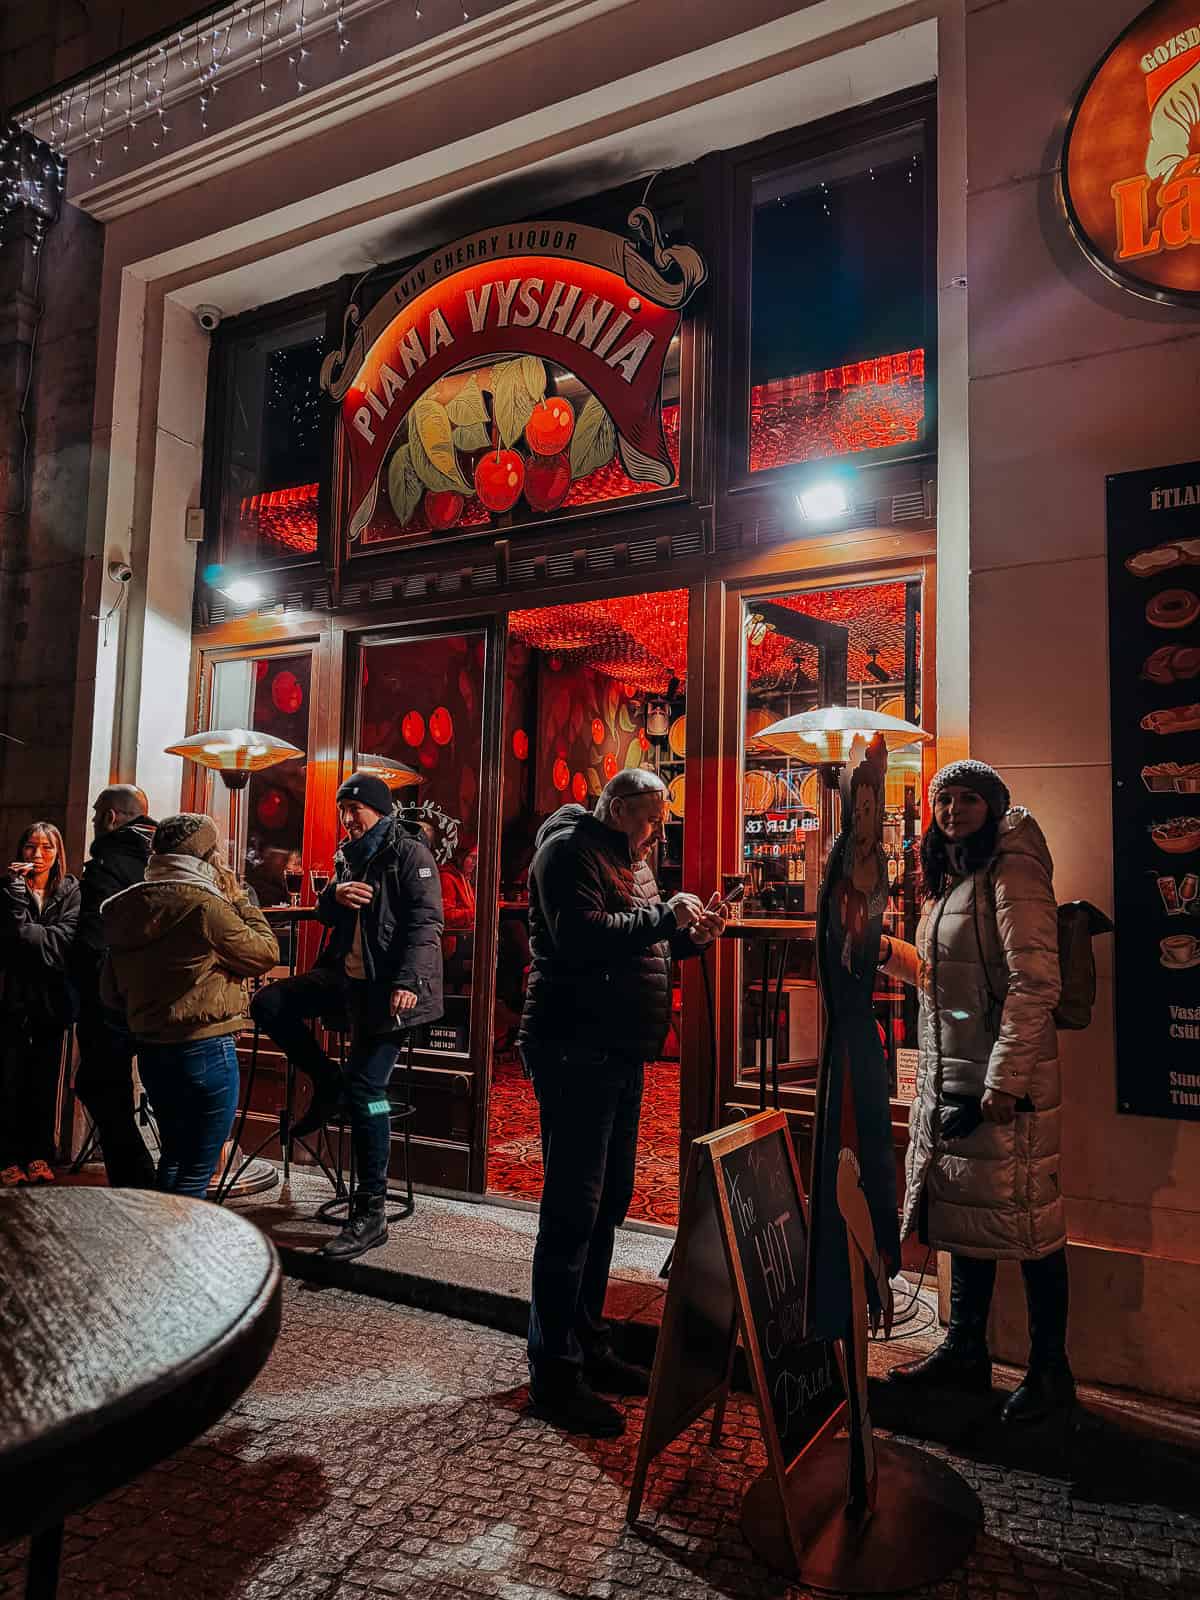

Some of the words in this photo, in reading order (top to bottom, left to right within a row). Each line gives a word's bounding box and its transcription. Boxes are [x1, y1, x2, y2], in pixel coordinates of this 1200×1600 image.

[394, 270, 427, 305] LVIV
[434, 235, 500, 273] CHERRY
[508, 229, 577, 252] LIQUOR
[353, 308, 455, 446] PIANA
[465, 278, 655, 384] VYSHNIA
[755, 1211, 797, 1310] HOT
